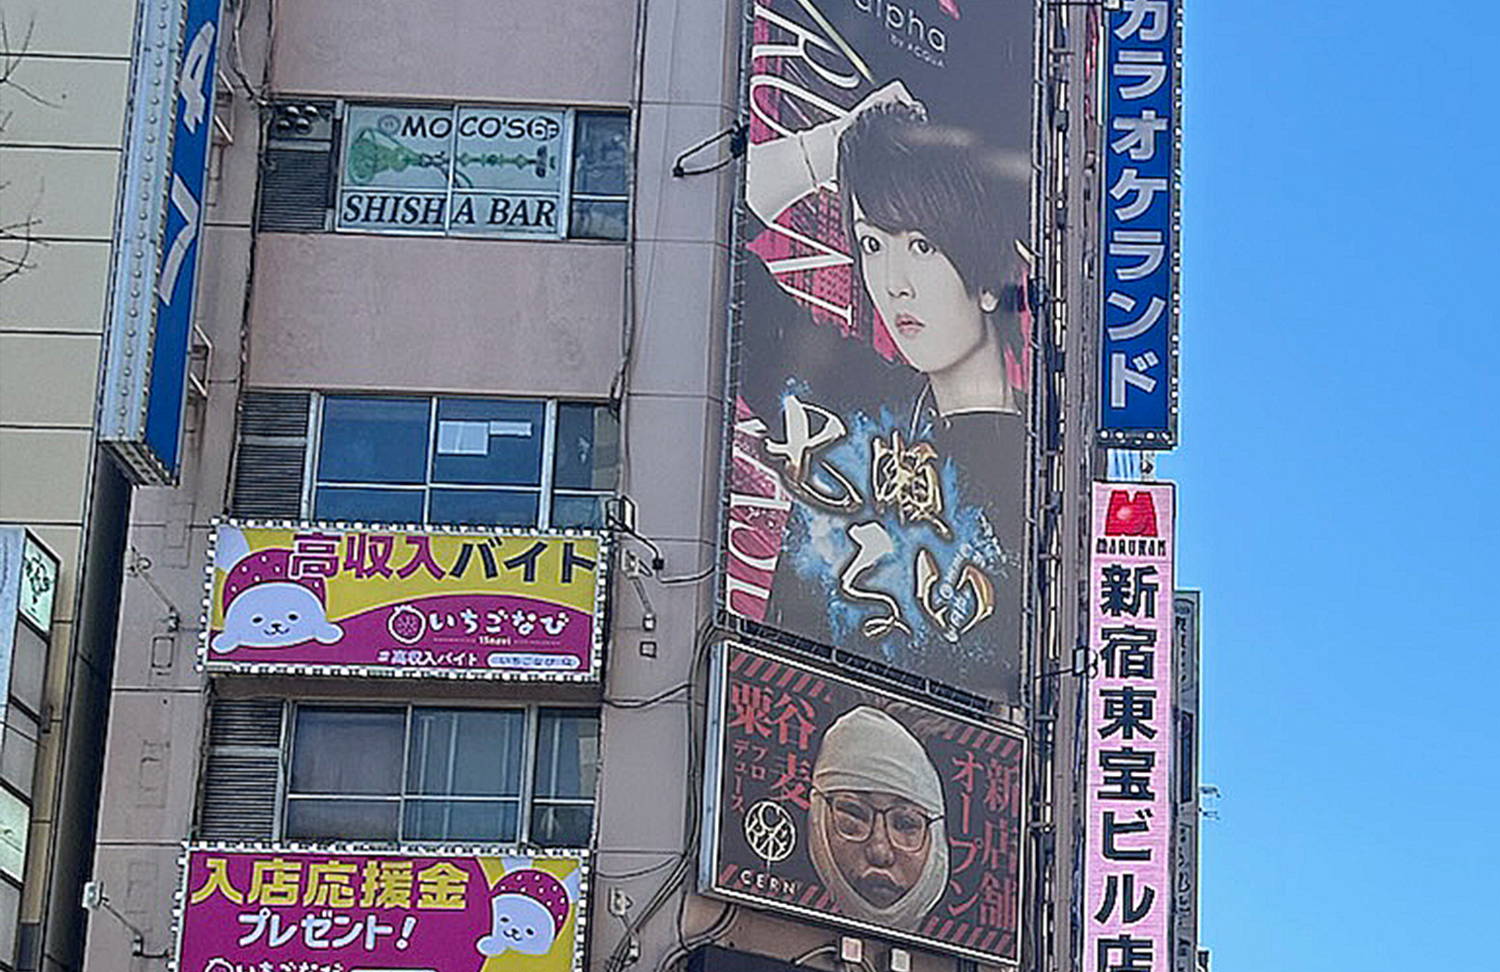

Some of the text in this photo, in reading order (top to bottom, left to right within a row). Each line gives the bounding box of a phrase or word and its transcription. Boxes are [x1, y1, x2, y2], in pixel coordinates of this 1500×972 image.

[344, 195, 556, 227] SHISHA BAR
[1107, 0, 1168, 408] カラオケランド
[290, 532, 597, 584] 高収入バイト
[429, 610, 570, 636] いちごなび
[949, 750, 984, 917] オープン
[191, 858, 470, 911] 入店応援金
[740, 869, 797, 896] CERN
[237, 907, 417, 951] プレゼント!
